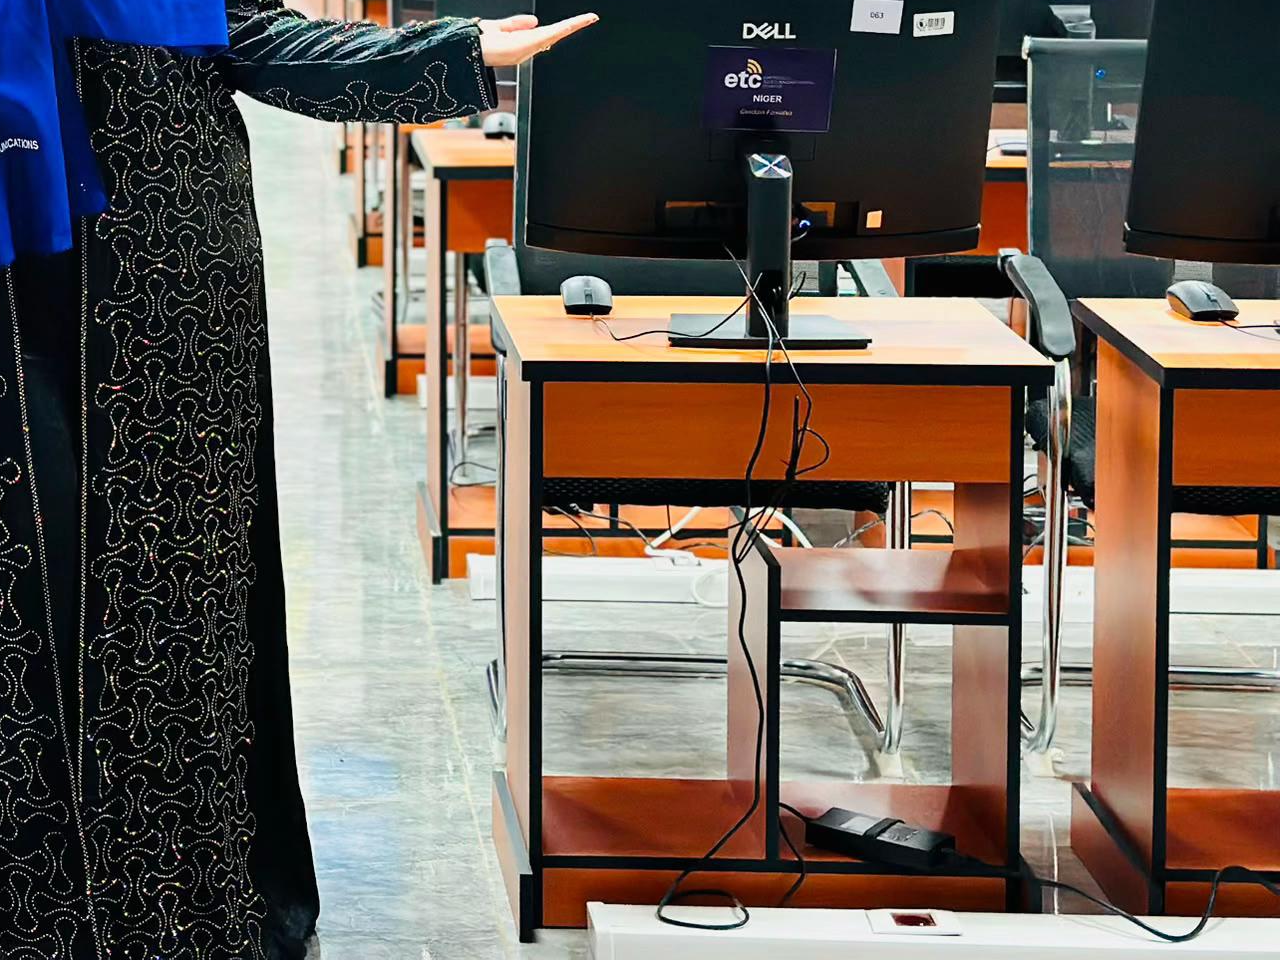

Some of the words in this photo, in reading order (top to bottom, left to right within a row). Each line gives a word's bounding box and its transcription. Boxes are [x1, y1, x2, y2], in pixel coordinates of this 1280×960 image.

[742, 22, 797, 40] DELL
[724, 70, 762, 89] etc
[753, 94, 782, 103] NIGER
